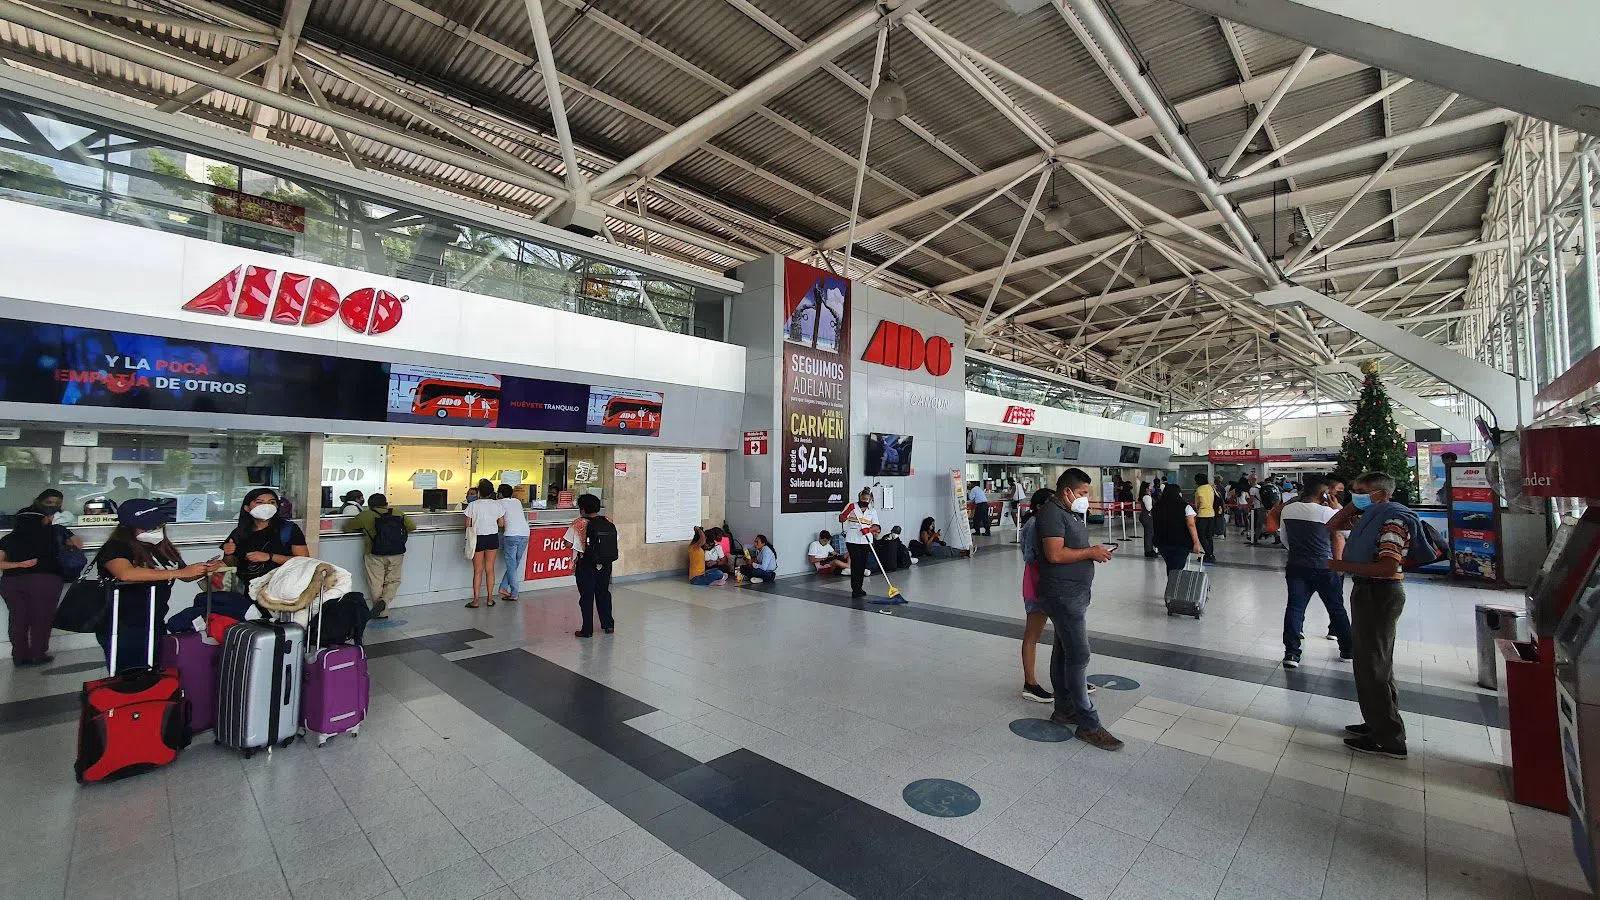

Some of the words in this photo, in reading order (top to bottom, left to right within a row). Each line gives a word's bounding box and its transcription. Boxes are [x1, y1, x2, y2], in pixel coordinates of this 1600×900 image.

[280, 204, 292, 213] DE
[182, 264, 403, 336] ADO
[860, 319, 952, 377] ADO
[104, 354, 119, 368] Y
[125, 356, 150, 371] LA
[155, 359, 209, 376] POCA
[791, 353, 844, 381] SEGUIMOS
[155, 376, 181, 390] DE
[184, 379, 247, 395] OTROS
[792, 375, 842, 401] ADELANTE
[437, 398, 462, 407] ADO
[544, 403, 580, 412] TRANQUILO
[618, 412, 637, 420] ADO
[790, 412, 844, 440] CARMEN
[789, 449, 797, 473] desde
[827, 466, 843, 475] pesos
[790, 477, 815, 488] Saliendo
[815, 478, 823, 488] de
[532, 560, 545, 573] tu
[547, 556, 572, 572] FAC
